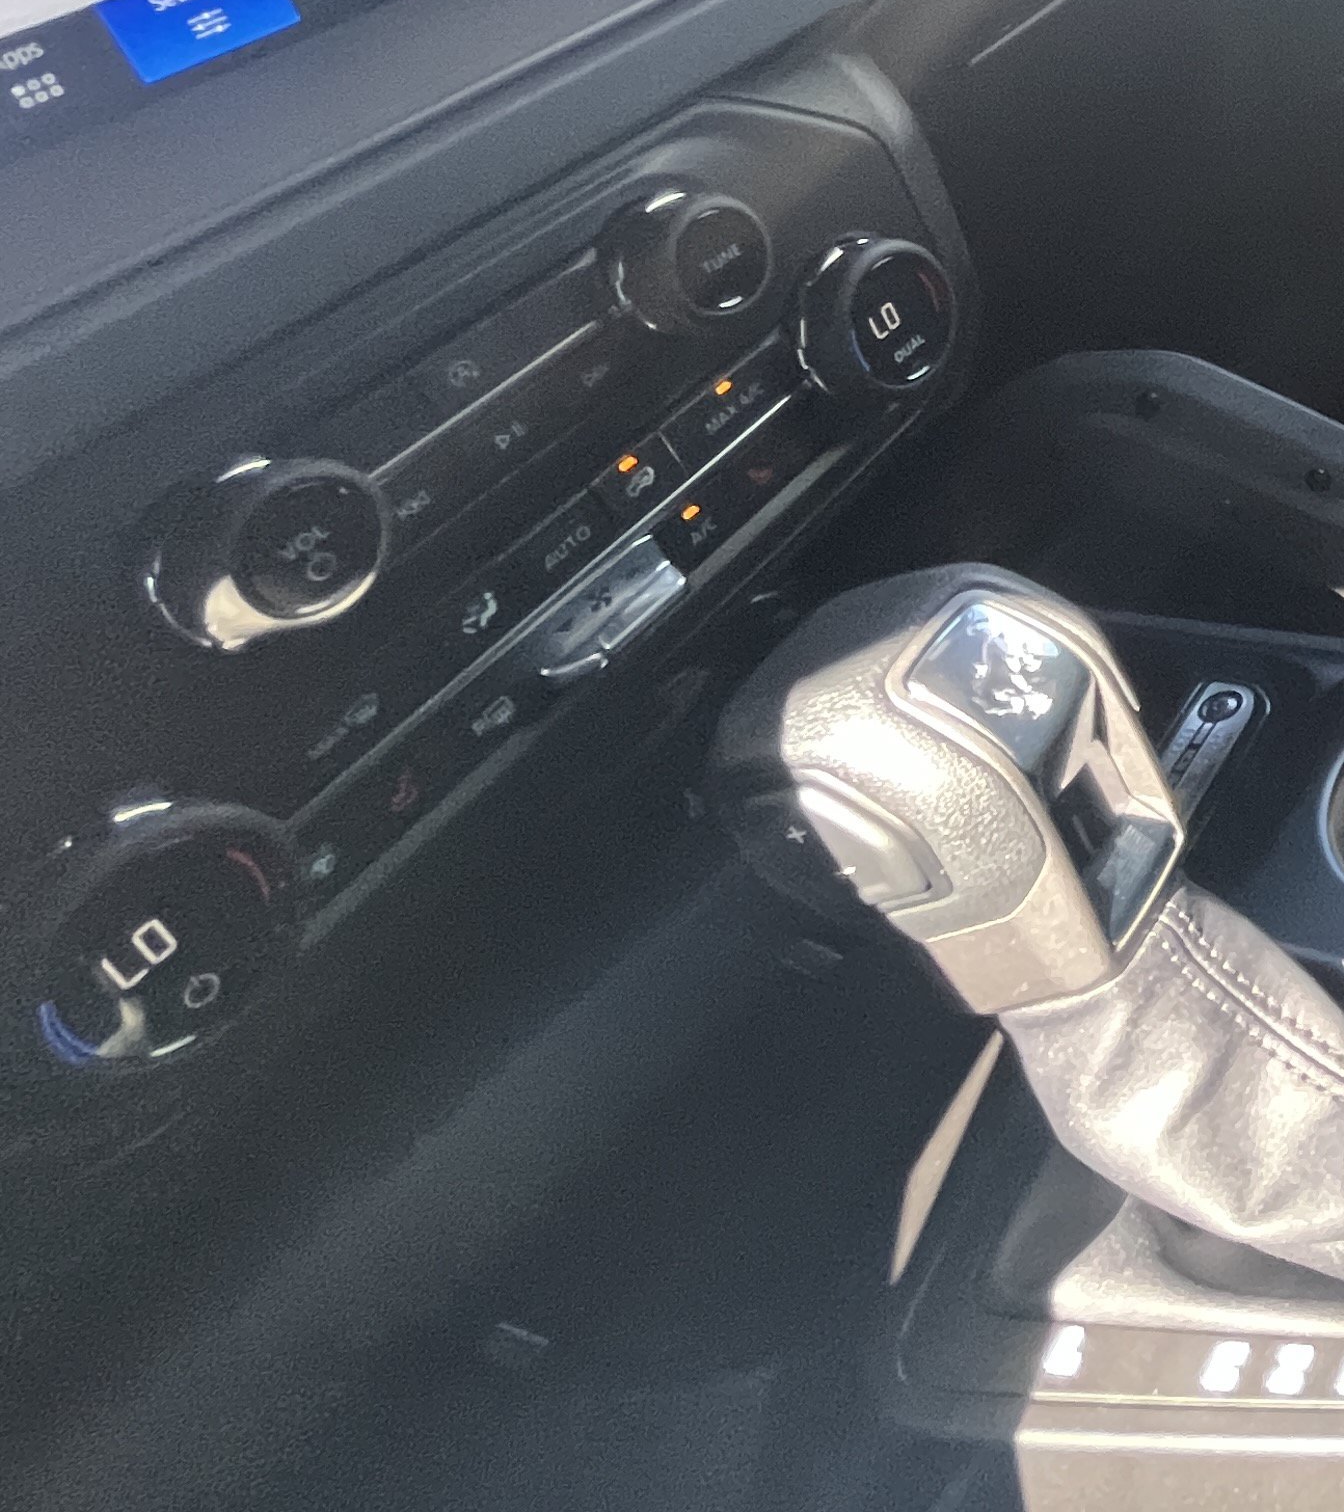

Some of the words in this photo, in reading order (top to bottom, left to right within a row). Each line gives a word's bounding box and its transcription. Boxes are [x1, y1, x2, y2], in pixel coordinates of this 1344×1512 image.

[0, 42, 44, 72] pps
[702, 243, 744, 274] TUNE
[868, 301, 901, 341] LO
[893, 334, 926, 364] DUAL
[704, 404, 738, 436] MAX
[277, 526, 331, 561] VOL
[690, 517, 718, 546] A/C
[544, 524, 592, 573] AUTO
[101, 918, 178, 991] LO
